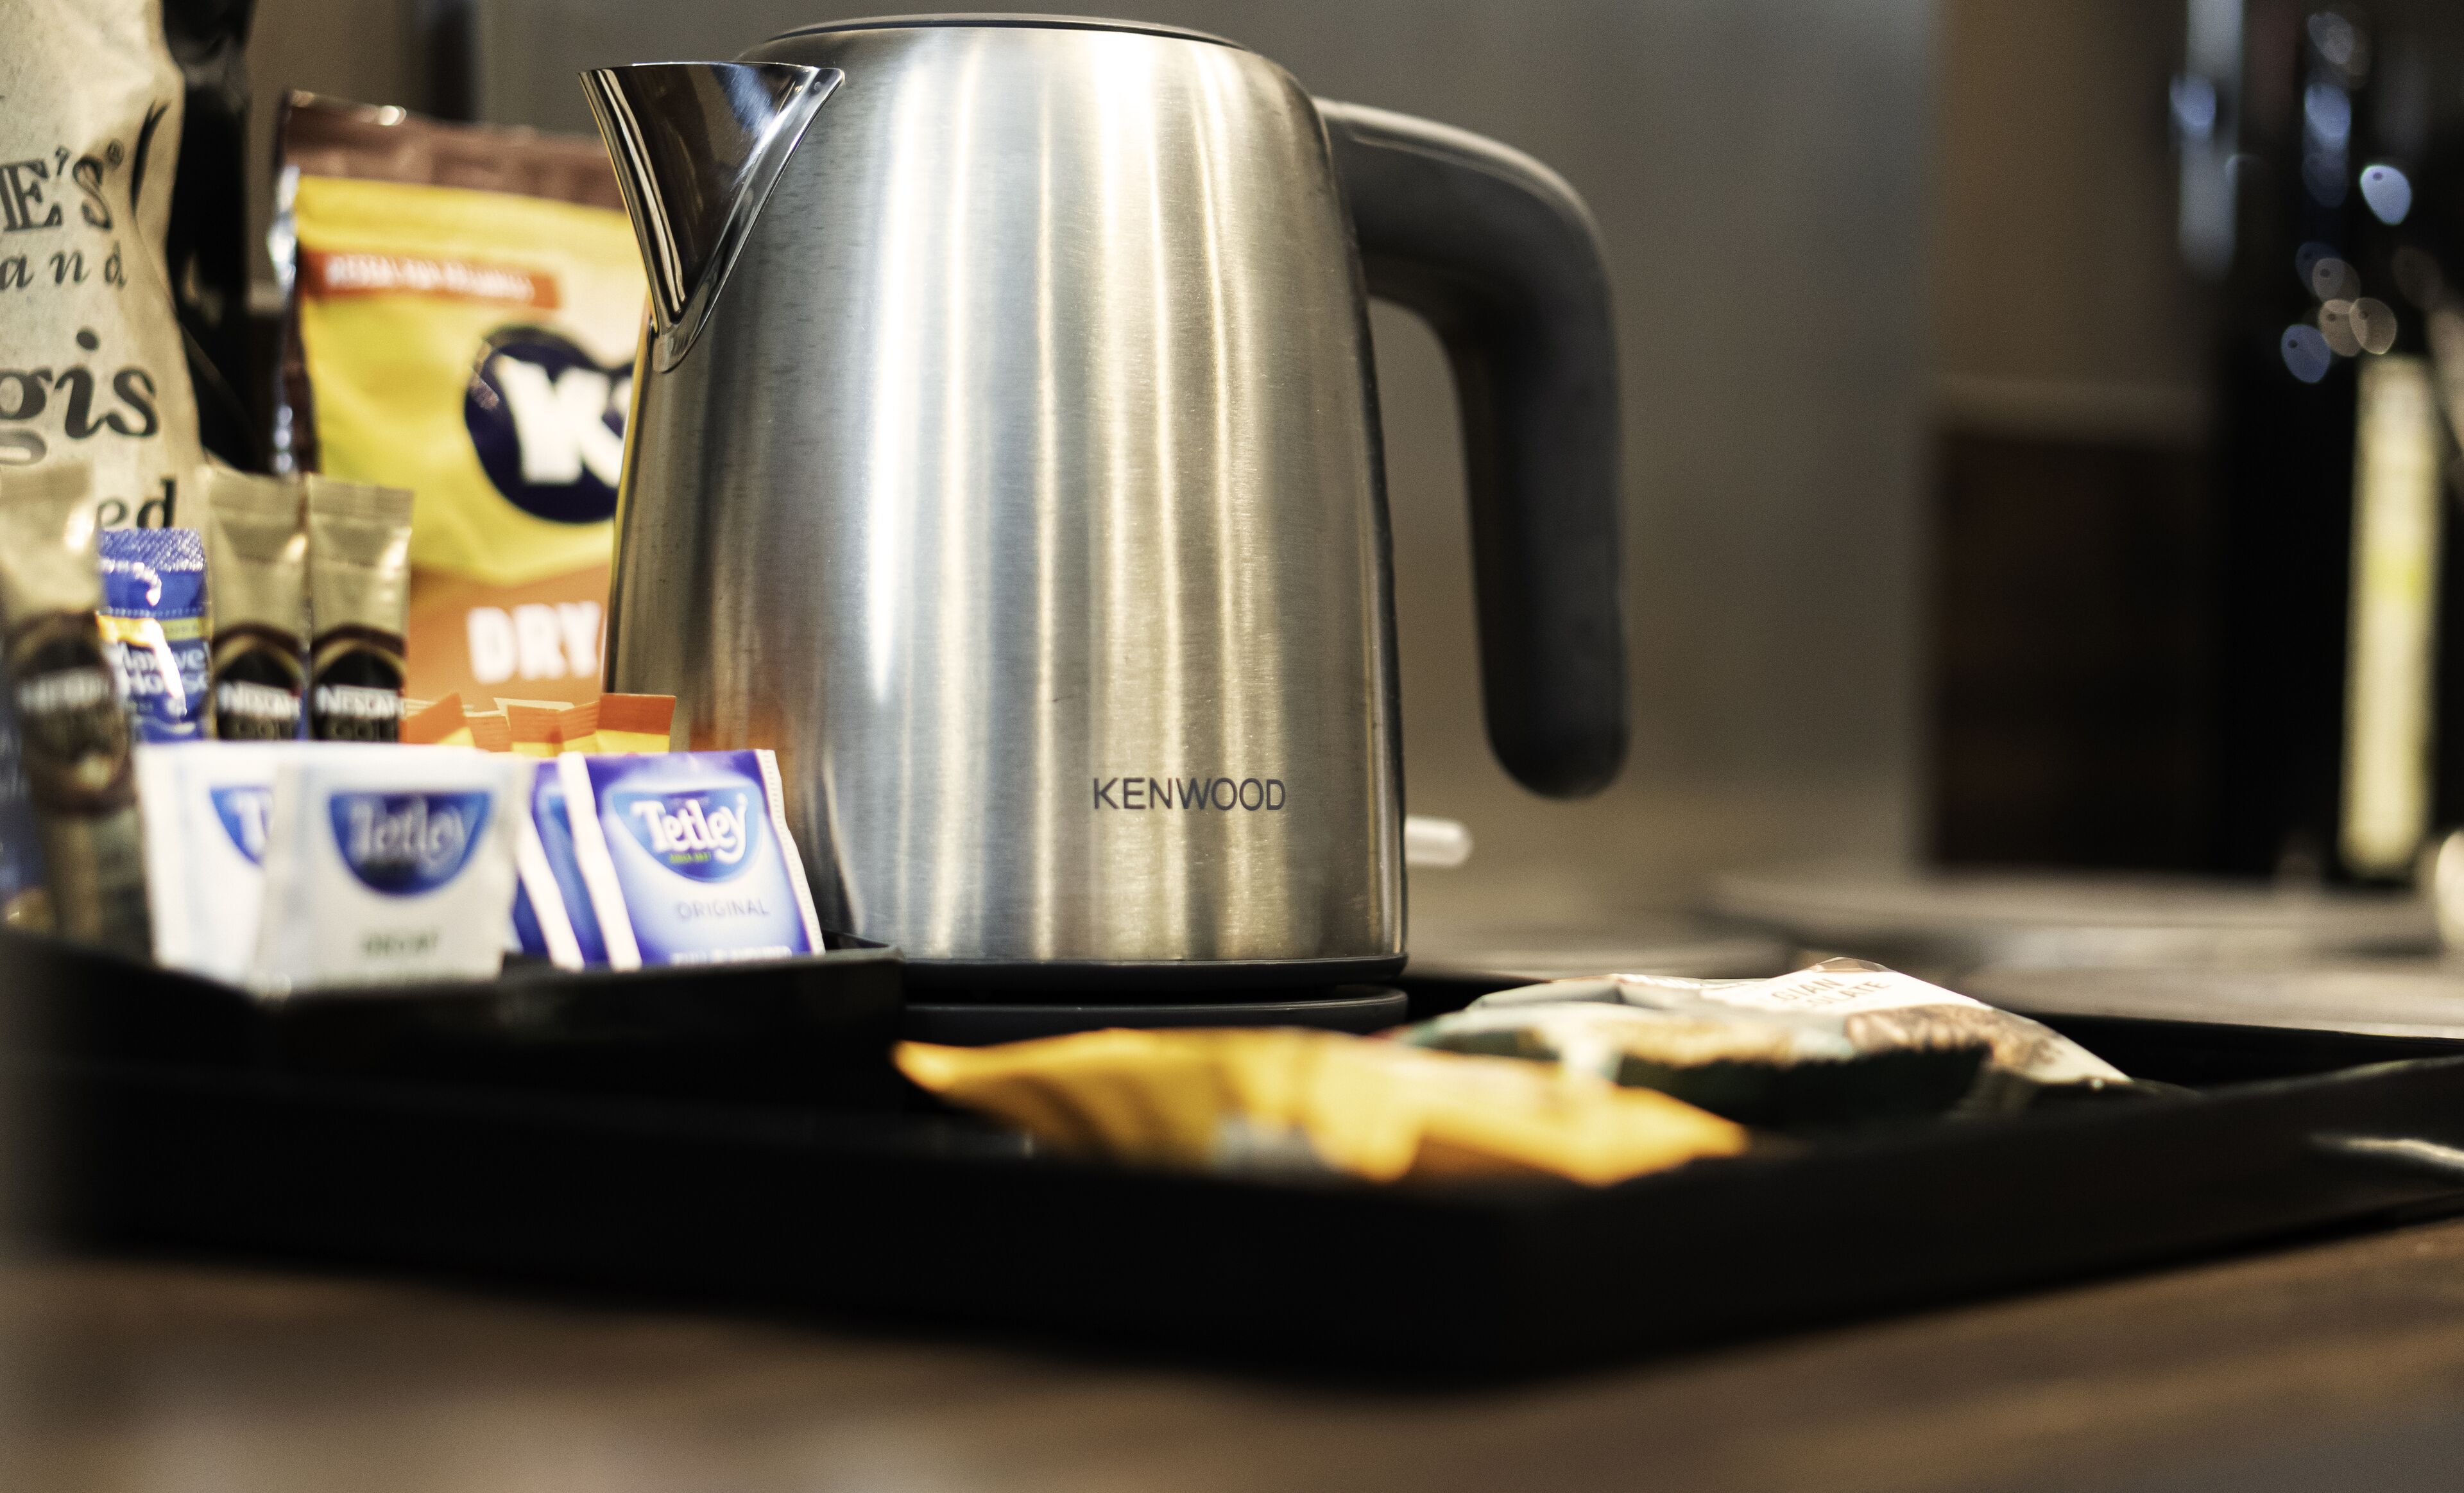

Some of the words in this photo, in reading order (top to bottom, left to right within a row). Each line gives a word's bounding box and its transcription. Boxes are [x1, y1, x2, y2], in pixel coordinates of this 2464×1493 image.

[467, 600, 601, 684] DRY
[1093, 777, 1286, 811] KENWOOD
[631, 792, 748, 864] Tetley
[677, 898, 769, 920] ORIGINAL
